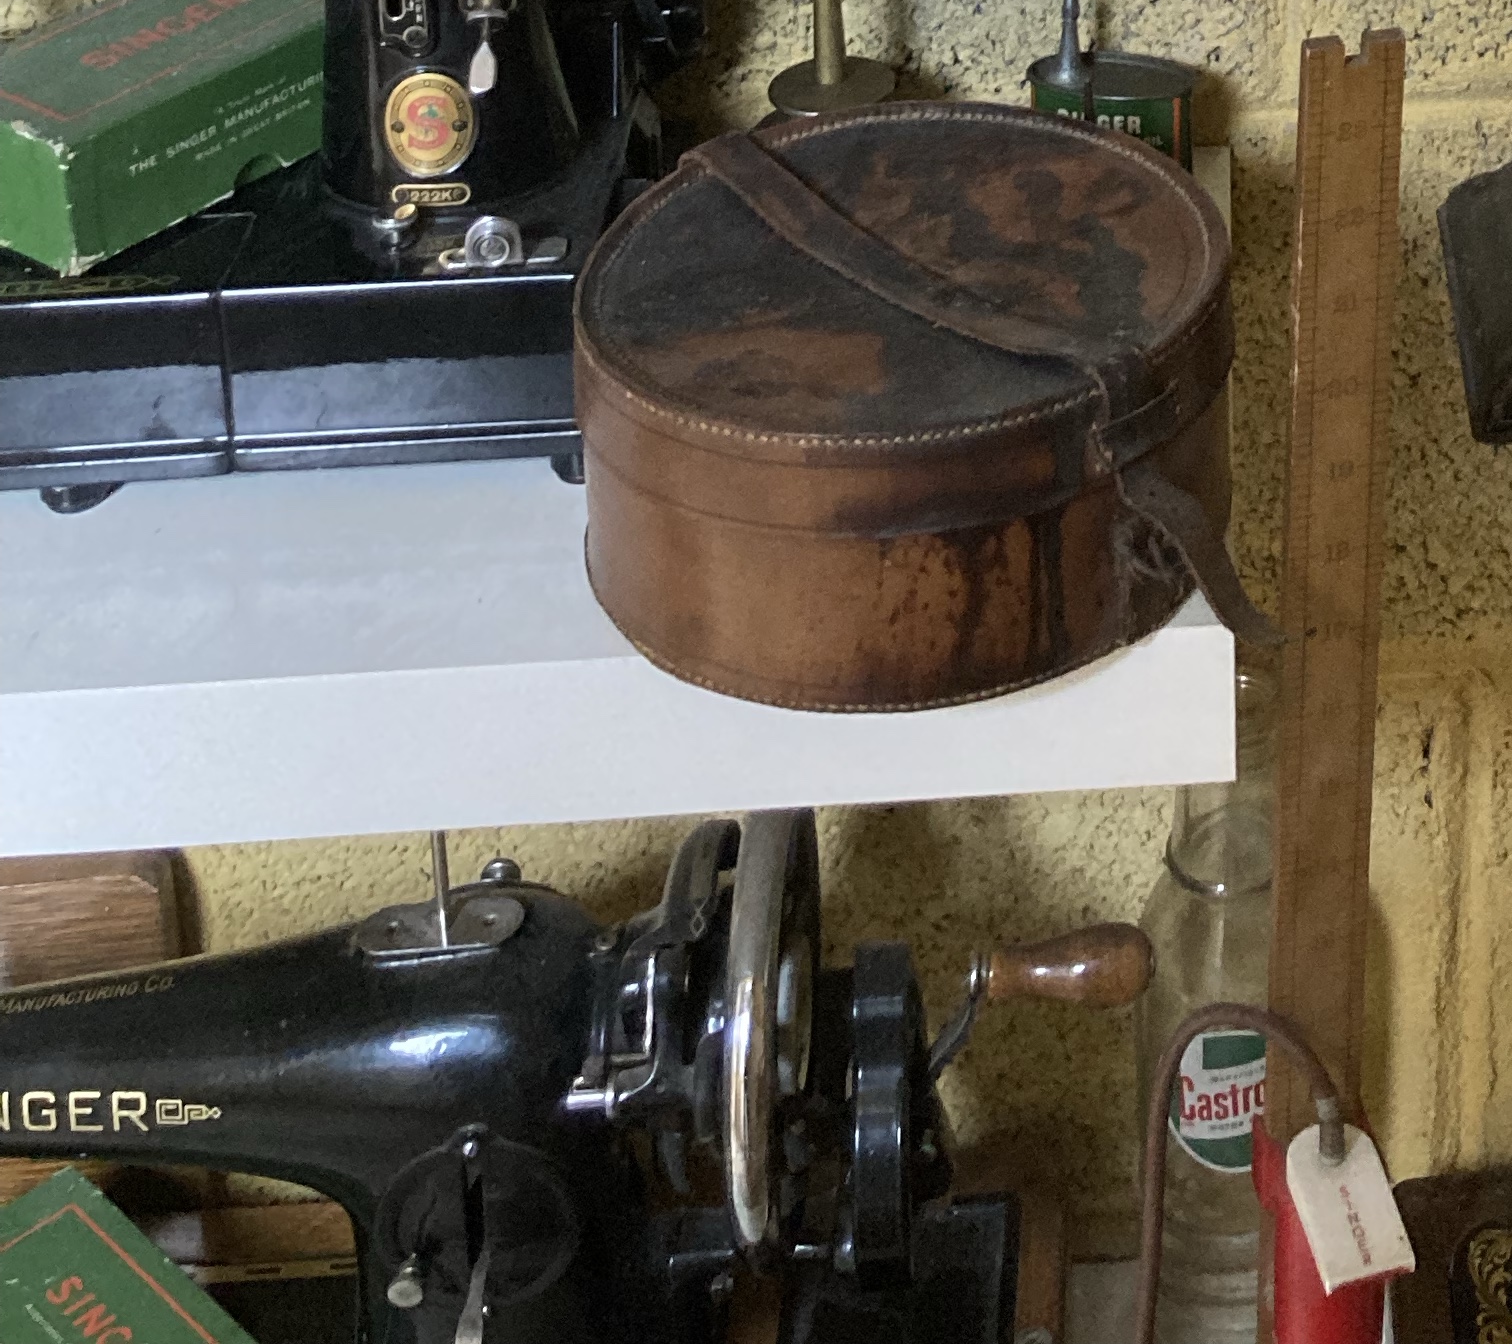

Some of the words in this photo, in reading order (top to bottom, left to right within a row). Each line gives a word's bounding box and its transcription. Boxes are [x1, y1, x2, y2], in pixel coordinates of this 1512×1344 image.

[129, 155, 158, 178] THE
[165, 124, 217, 160] SINGER
[410, 190, 452, 201] 222K
[1179, 1076, 1266, 1120] Castro
